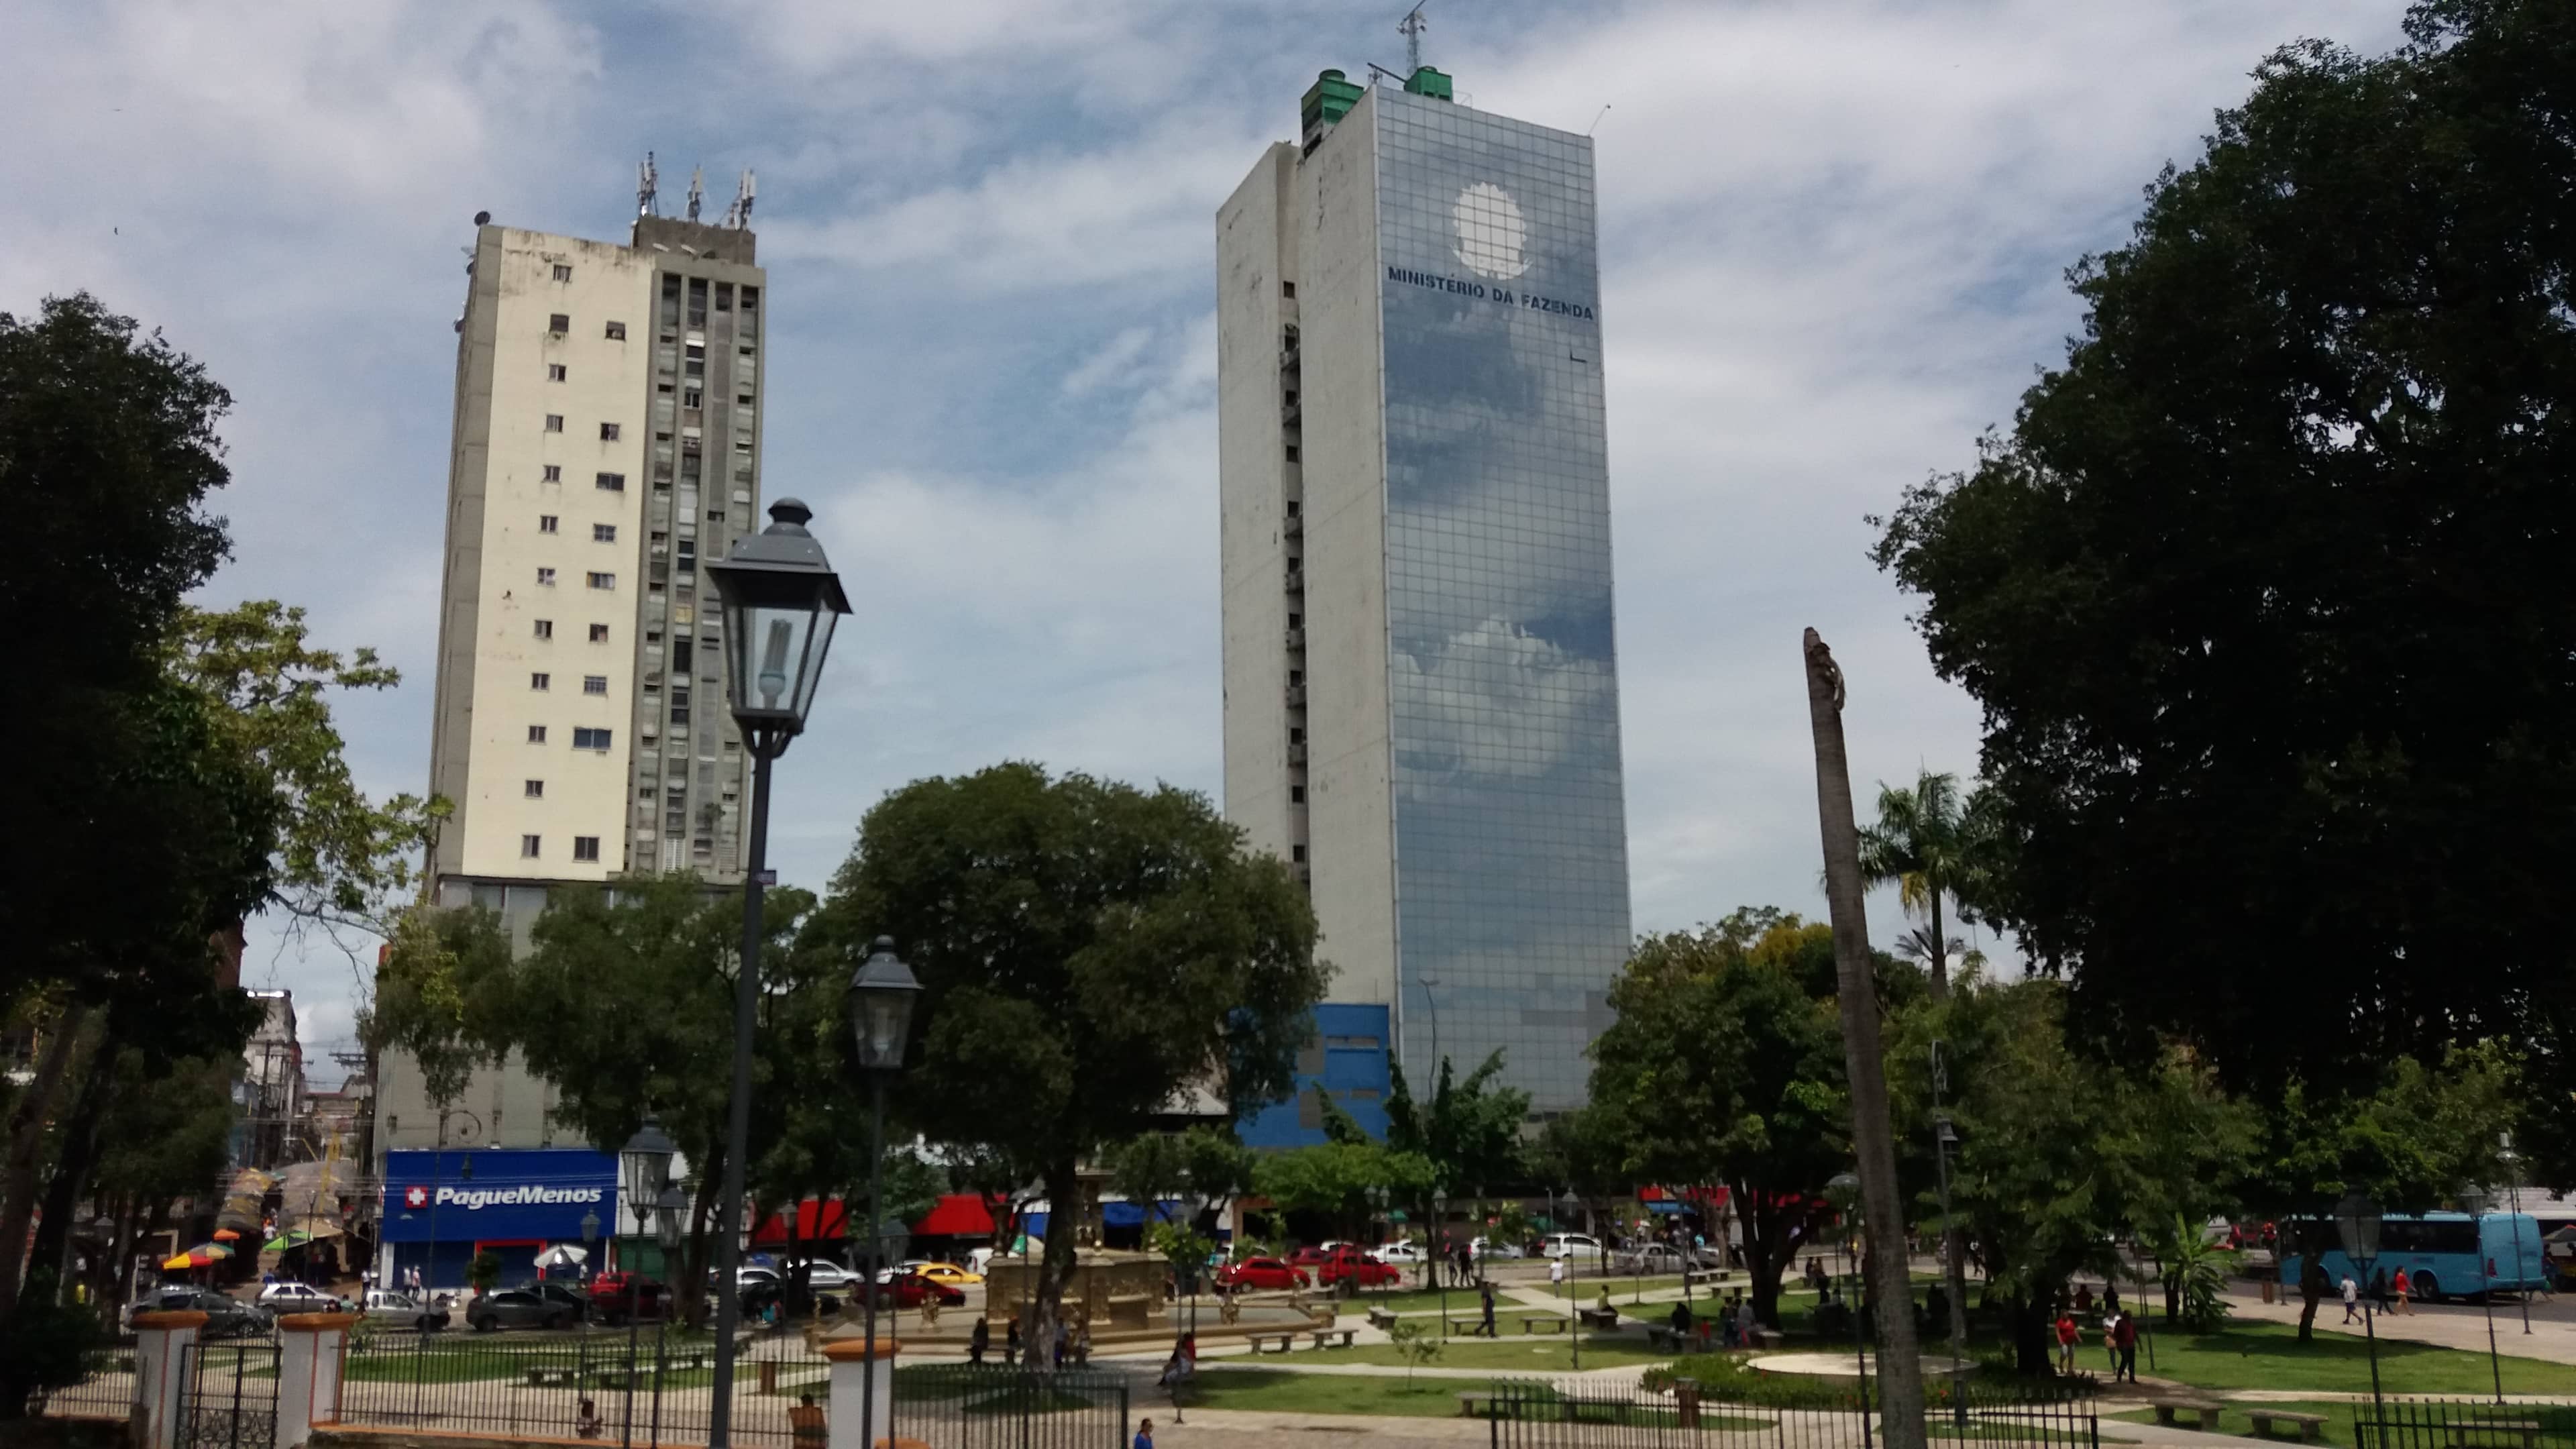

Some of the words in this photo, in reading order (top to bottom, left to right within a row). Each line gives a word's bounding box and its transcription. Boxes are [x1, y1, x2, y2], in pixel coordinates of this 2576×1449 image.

[1388, 266, 1485, 299] MINISTÉRIO
[1492, 288, 1513, 305] DA
[1521, 294, 1593, 320] FAZENDA
